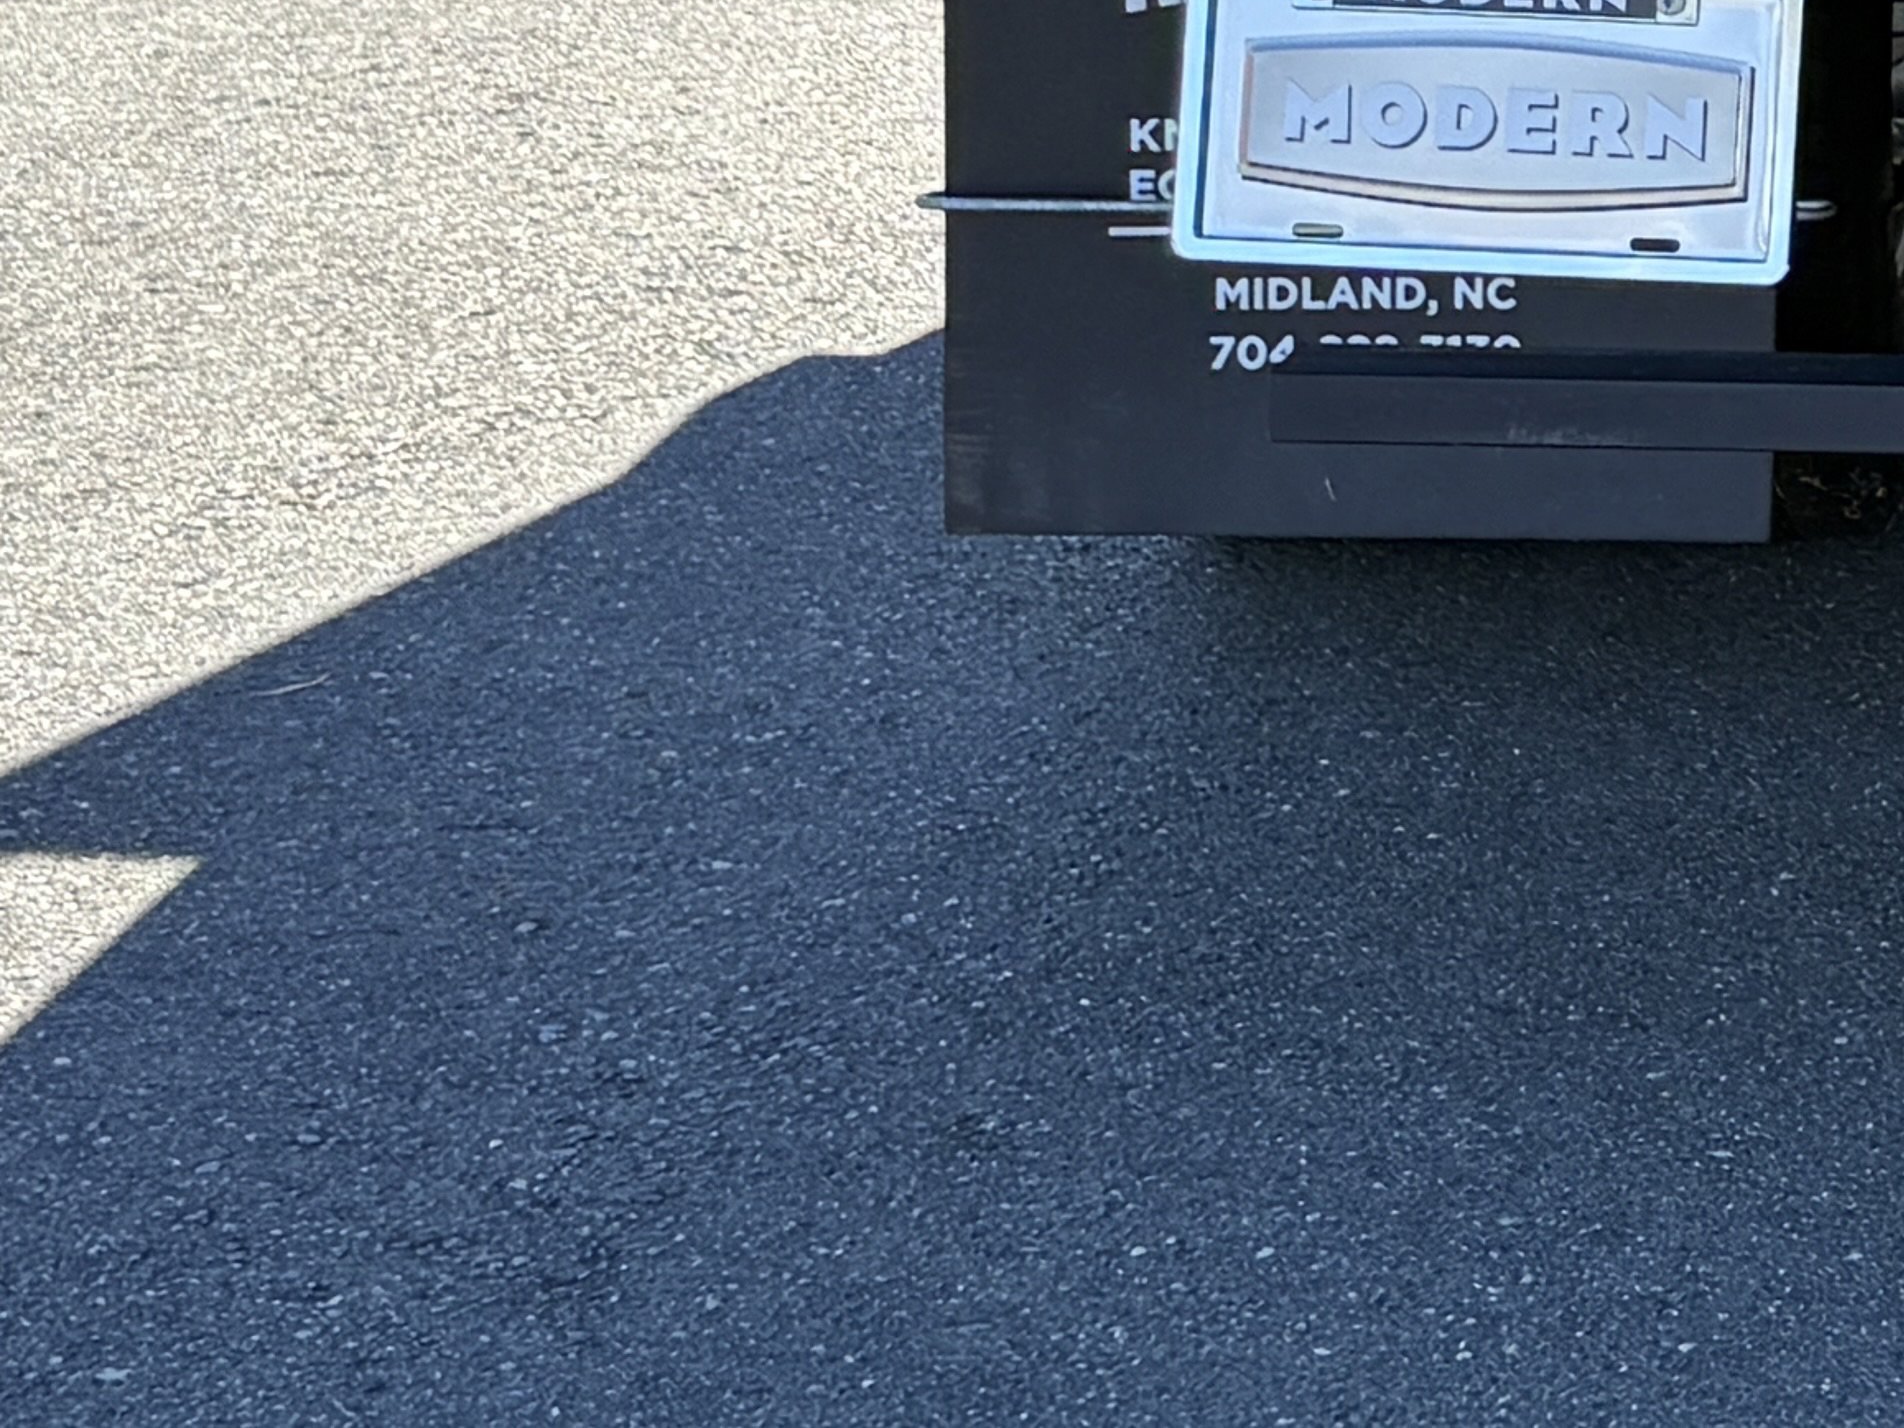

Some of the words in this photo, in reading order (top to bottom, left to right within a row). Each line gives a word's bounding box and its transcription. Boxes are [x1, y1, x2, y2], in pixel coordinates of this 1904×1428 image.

[1284, 77, 1709, 163] MODERN
[1214, 275, 1439, 317] MIDLAND,
[1453, 276, 1518, 311] NC
